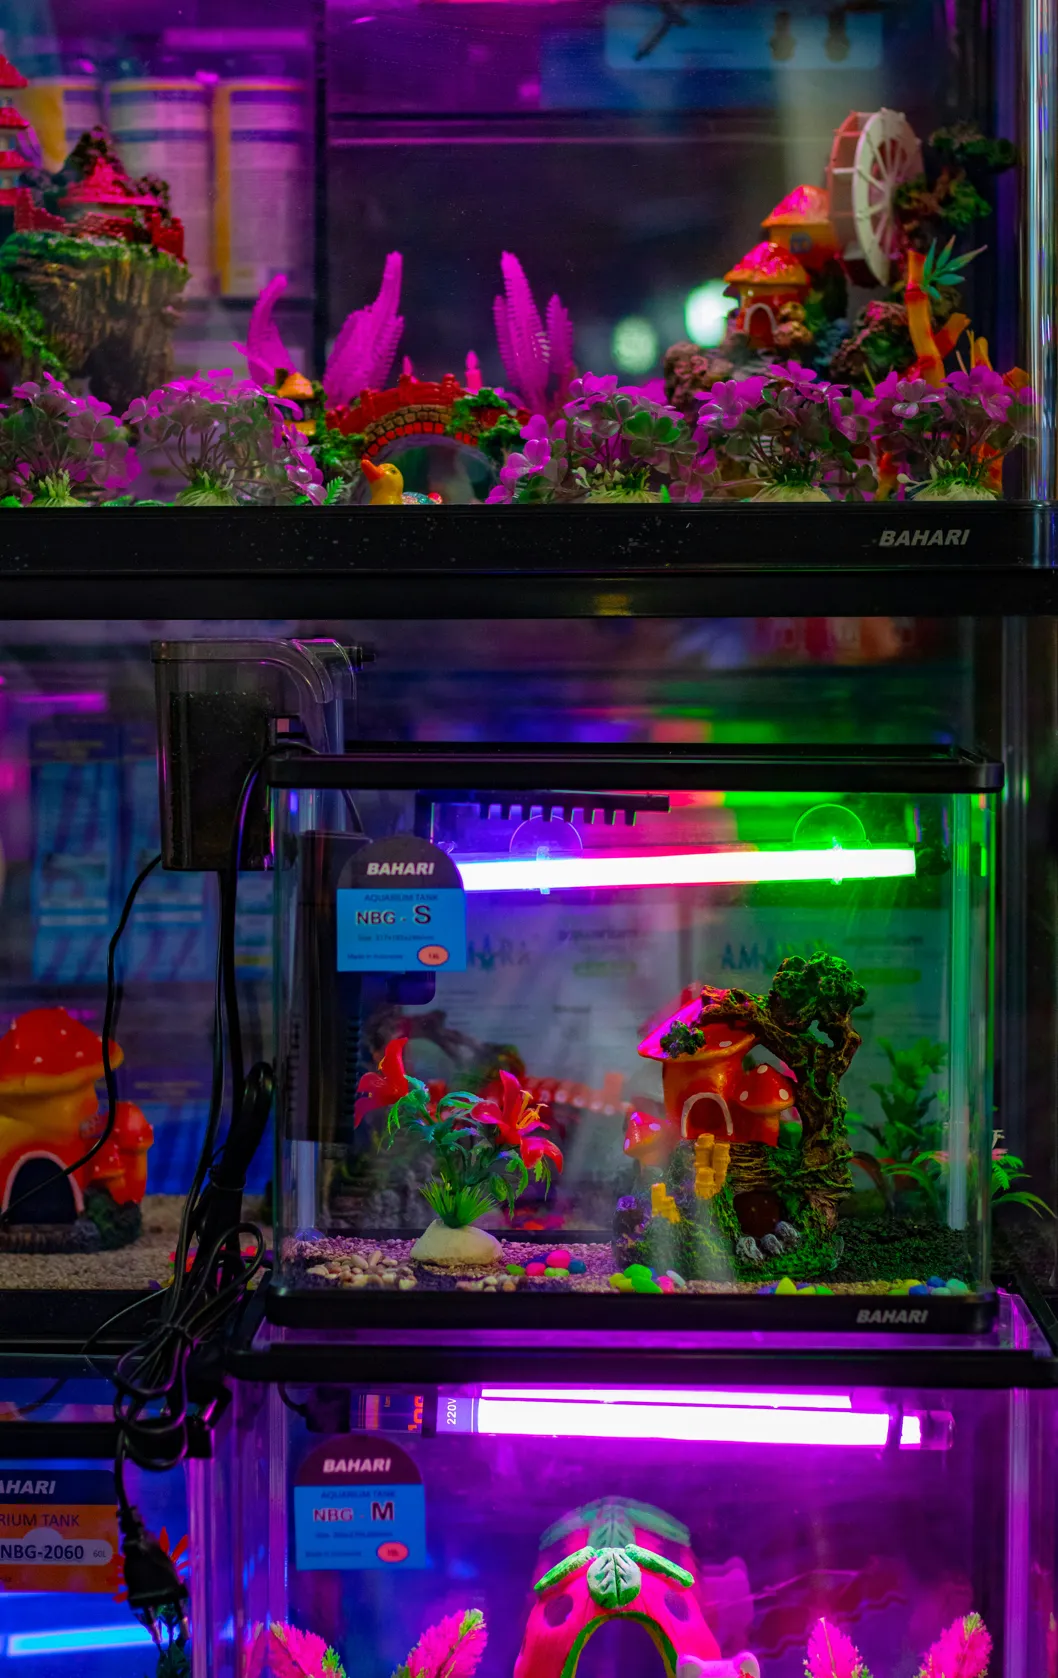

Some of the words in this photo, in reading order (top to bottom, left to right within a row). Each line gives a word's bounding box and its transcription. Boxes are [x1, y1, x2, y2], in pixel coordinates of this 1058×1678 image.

[879, 529, 970, 547] BAHARI
[366, 862, 435, 876] BAHARI
[355, 910, 396, 925] NBG
[413, 903, 432, 925] S
[856, 1309, 929, 1324] BAHARI
[446, 1398, 457, 1425] 220V
[323, 1458, 391, 1473] BAHARI
[313, 1508, 353, 1522] NBG
[371, 1501, 394, 1521] M
[42, 1514, 80, 1527] TANK
[1, 1544, 84, 1560] NBG-2060
[93, 1550, 107, 1558] 60L
